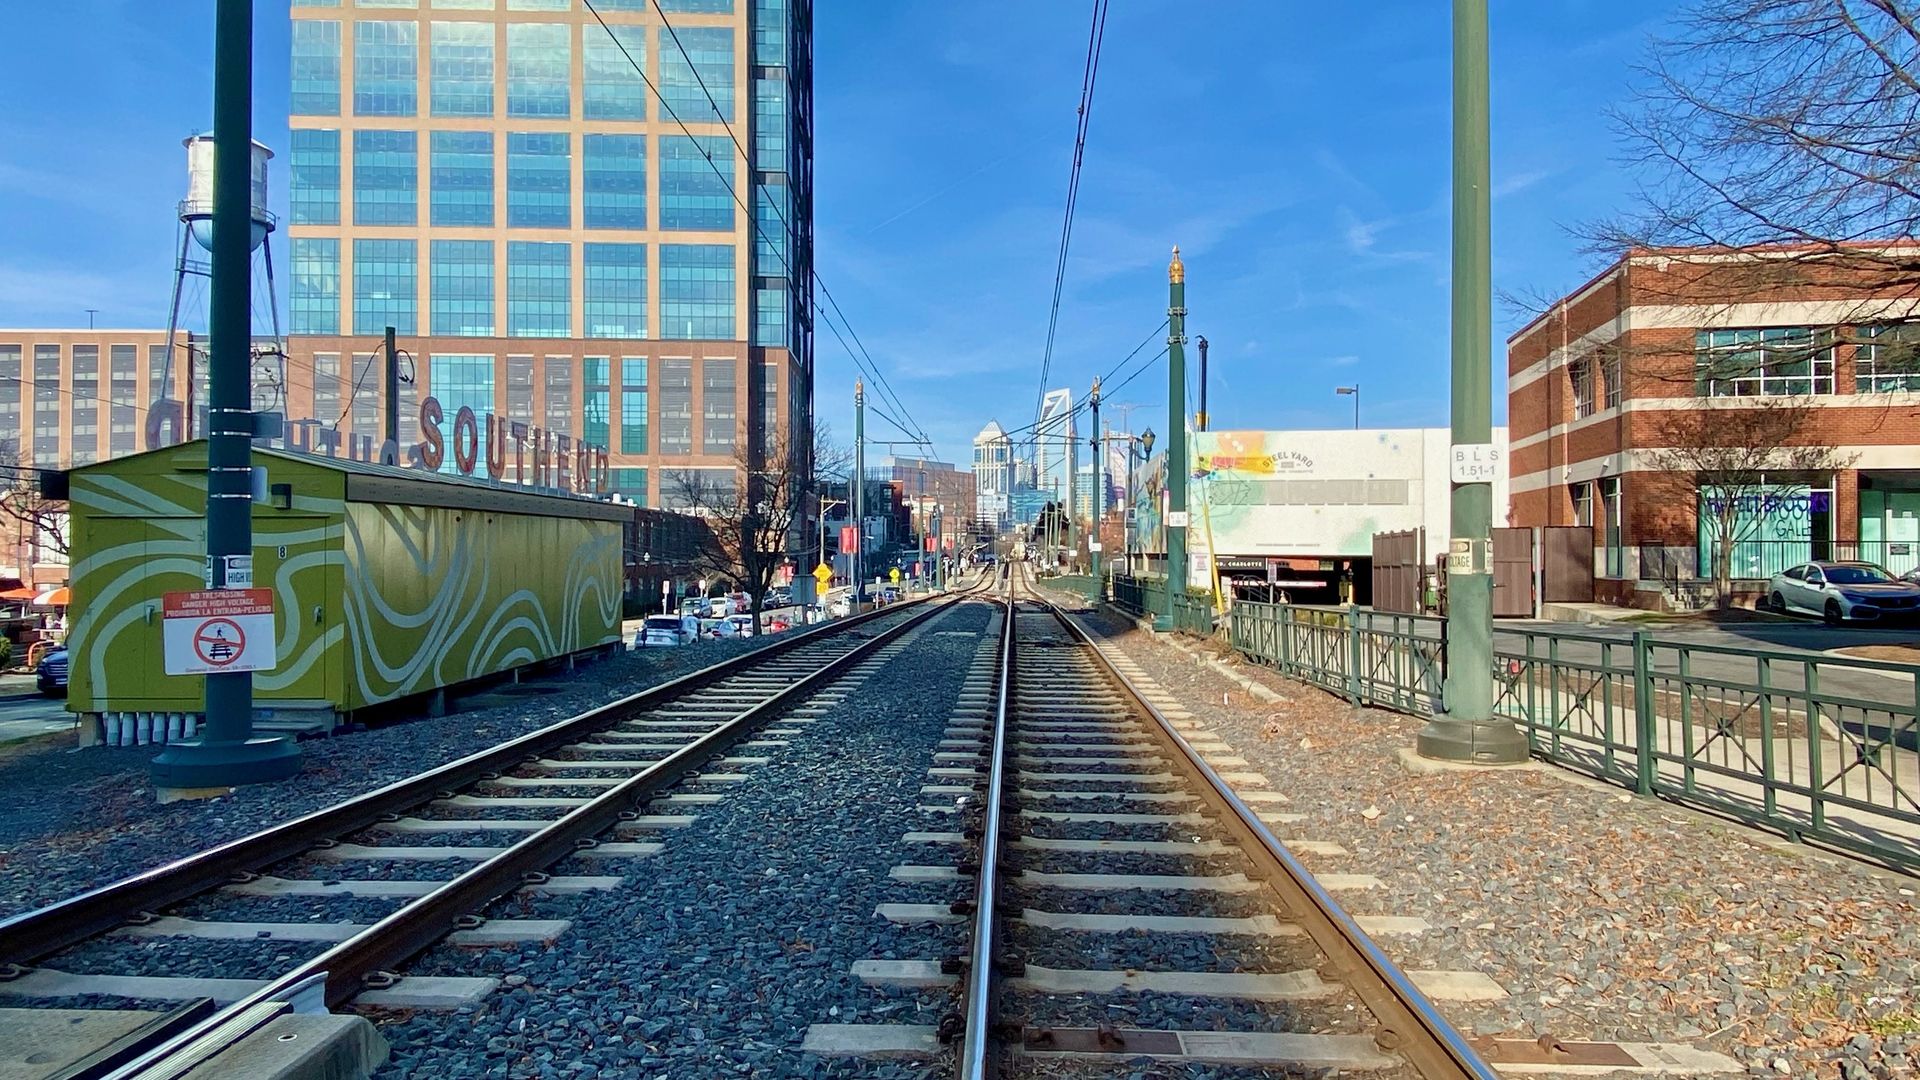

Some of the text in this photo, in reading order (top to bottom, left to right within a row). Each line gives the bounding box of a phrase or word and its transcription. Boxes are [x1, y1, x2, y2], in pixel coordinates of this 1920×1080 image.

[1262, 451, 1288, 468] STEEL
[1291, 451, 1313, 468] YARD
[1459, 465, 1495, 476] 1.51-1
[279, 546, 286, 558] 8
[1449, 555, 1470, 568] OLTAGE
[190, 591, 246, 600] NO TRESPASSING
[182, 598, 255, 609] DANGER HIGH VOLTAGE
[202, 608, 212, 616] LA
